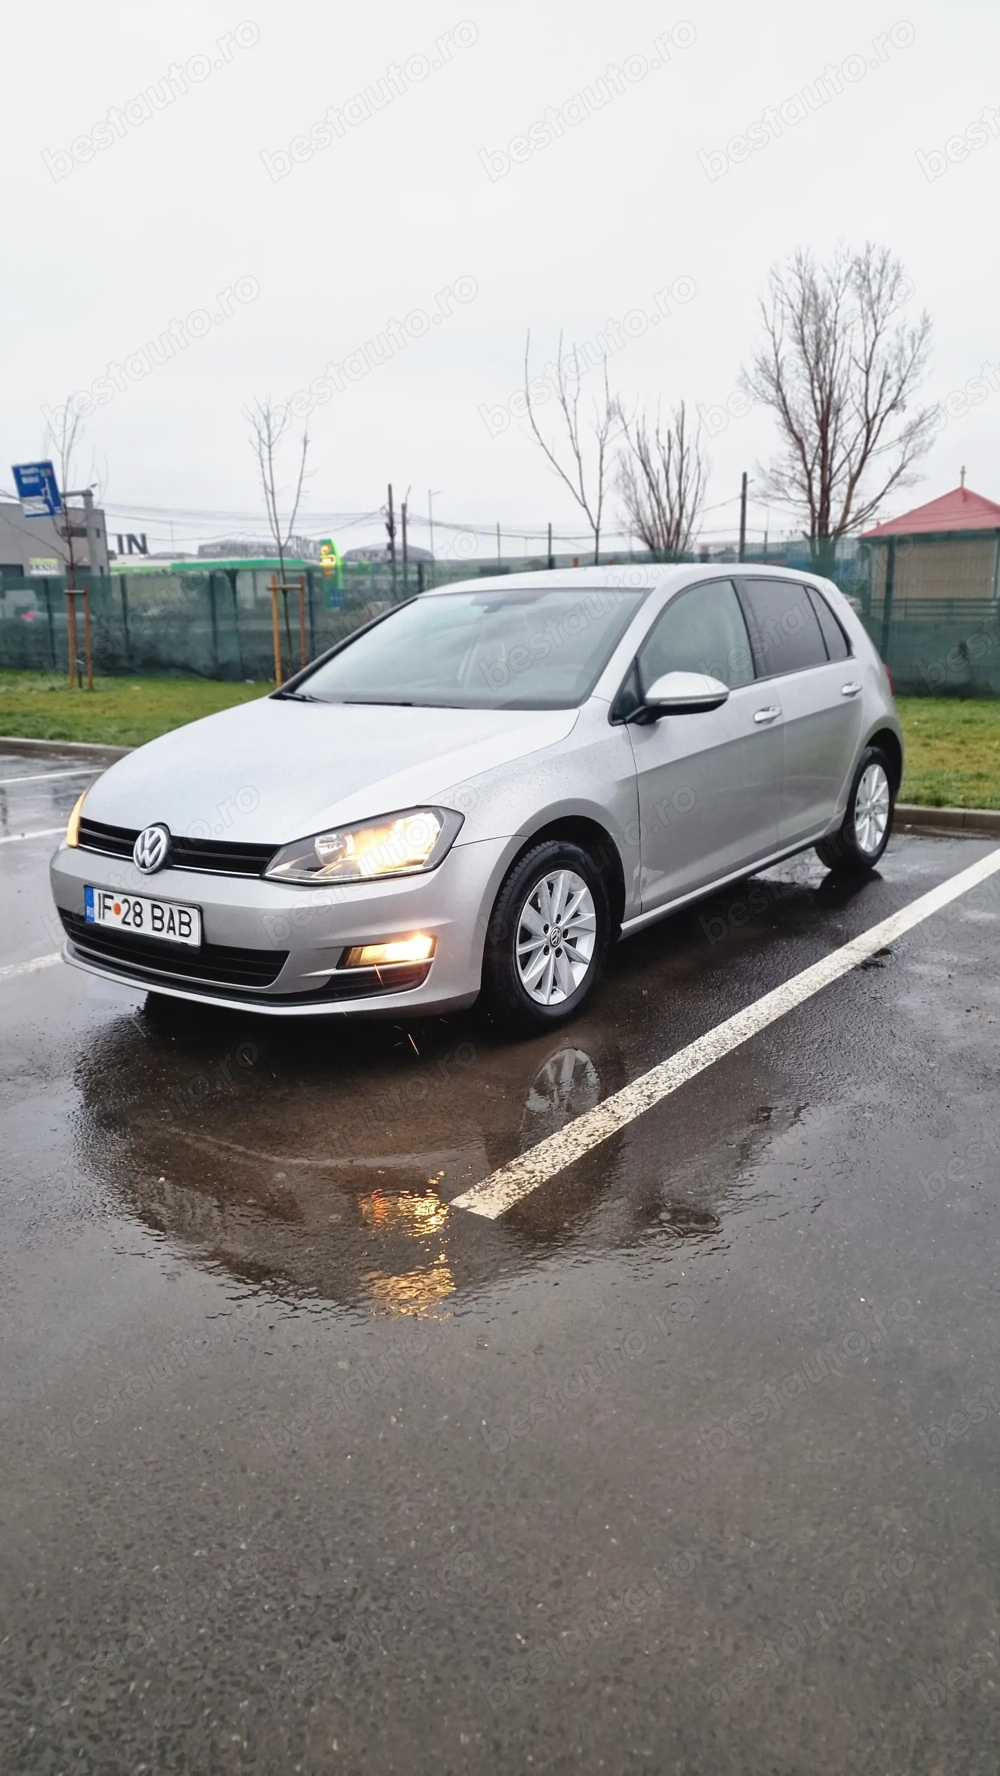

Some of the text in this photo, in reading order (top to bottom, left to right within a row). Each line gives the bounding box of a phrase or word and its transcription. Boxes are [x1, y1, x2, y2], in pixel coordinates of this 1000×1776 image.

[98, 892, 192, 938] IF 28 BAB
